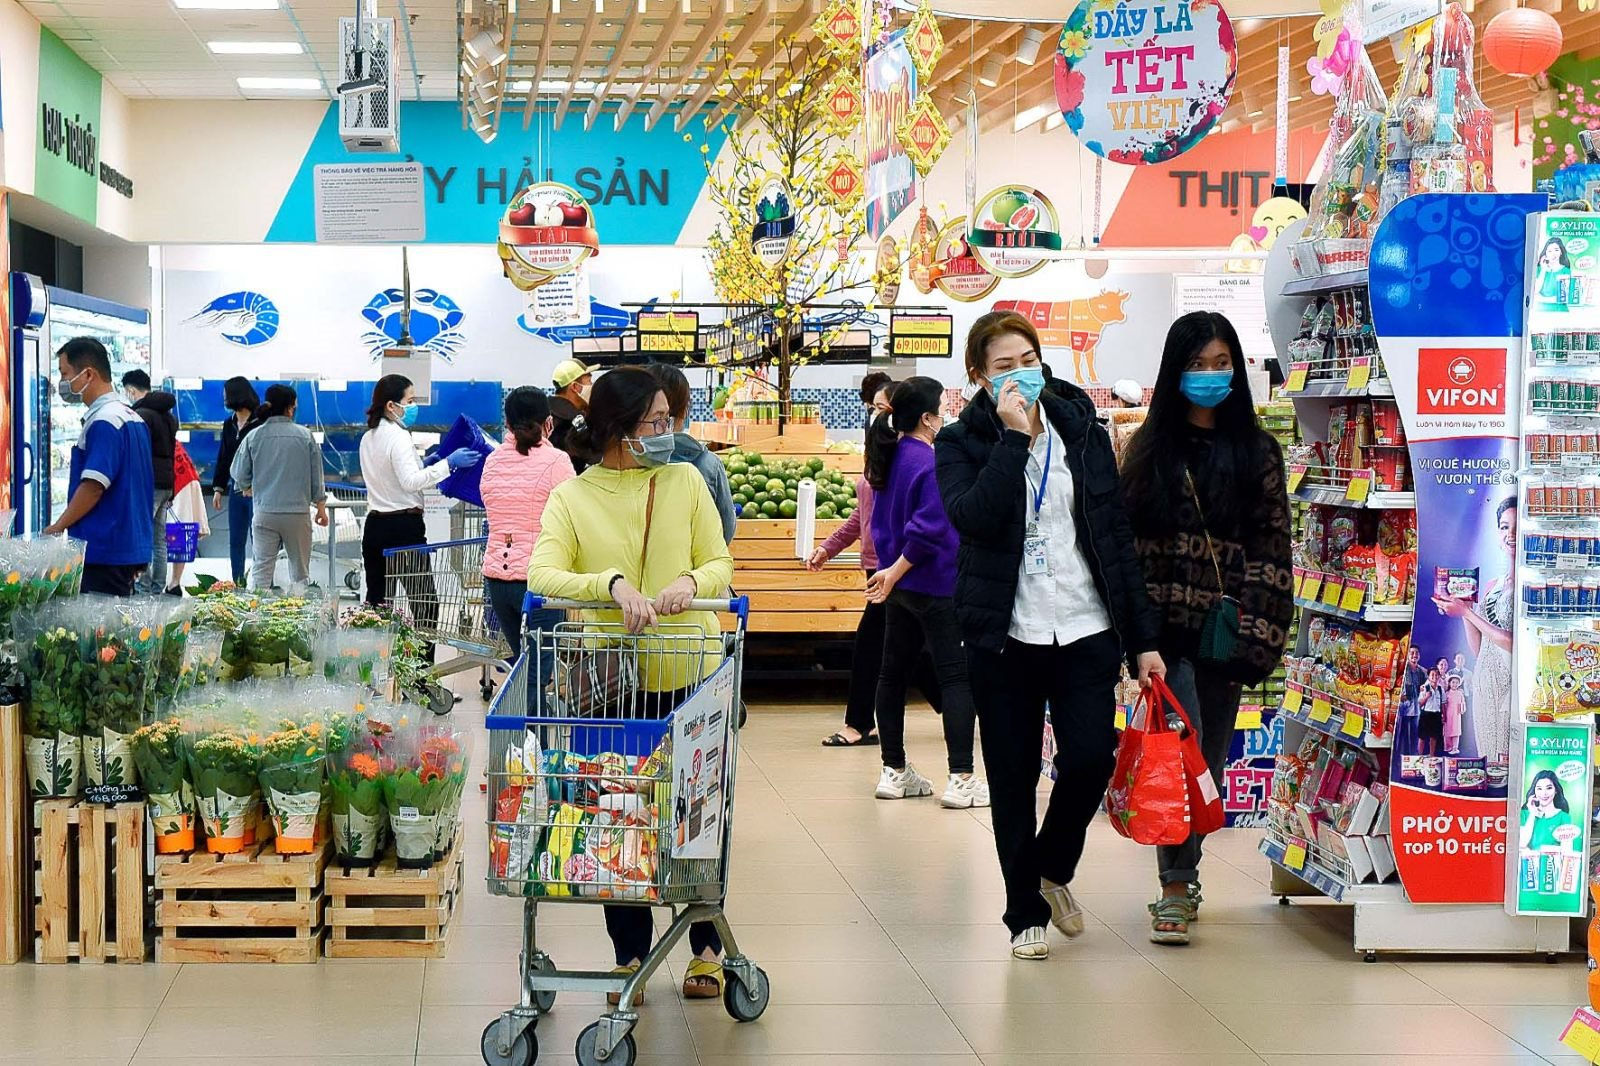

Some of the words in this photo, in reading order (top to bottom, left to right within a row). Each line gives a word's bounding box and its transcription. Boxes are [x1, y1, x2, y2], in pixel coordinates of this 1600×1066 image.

[1094, 2, 1147, 38] ĐÂY
[1154, 0, 1193, 34] LÀ
[1105, 35, 1194, 94] TẾT
[1107, 95, 1184, 133] VIỆT
[575, 157, 668, 205] SẢN
[1169, 170, 1270, 214] THỊT
[1560, 221, 1597, 230] XYLITOL
[1427, 388, 1498, 407] VIFON
[1432, 456, 1459, 469] QUÊ
[1247, 717, 1284, 755] ĐÂ
[1541, 738, 1585, 749] XYLITOL
[1403, 809, 1453, 833] PHỞ
[1403, 842, 1432, 854] TOP
[1436, 839, 1458, 854] 10
[1462, 836, 1491, 854] THẾ
